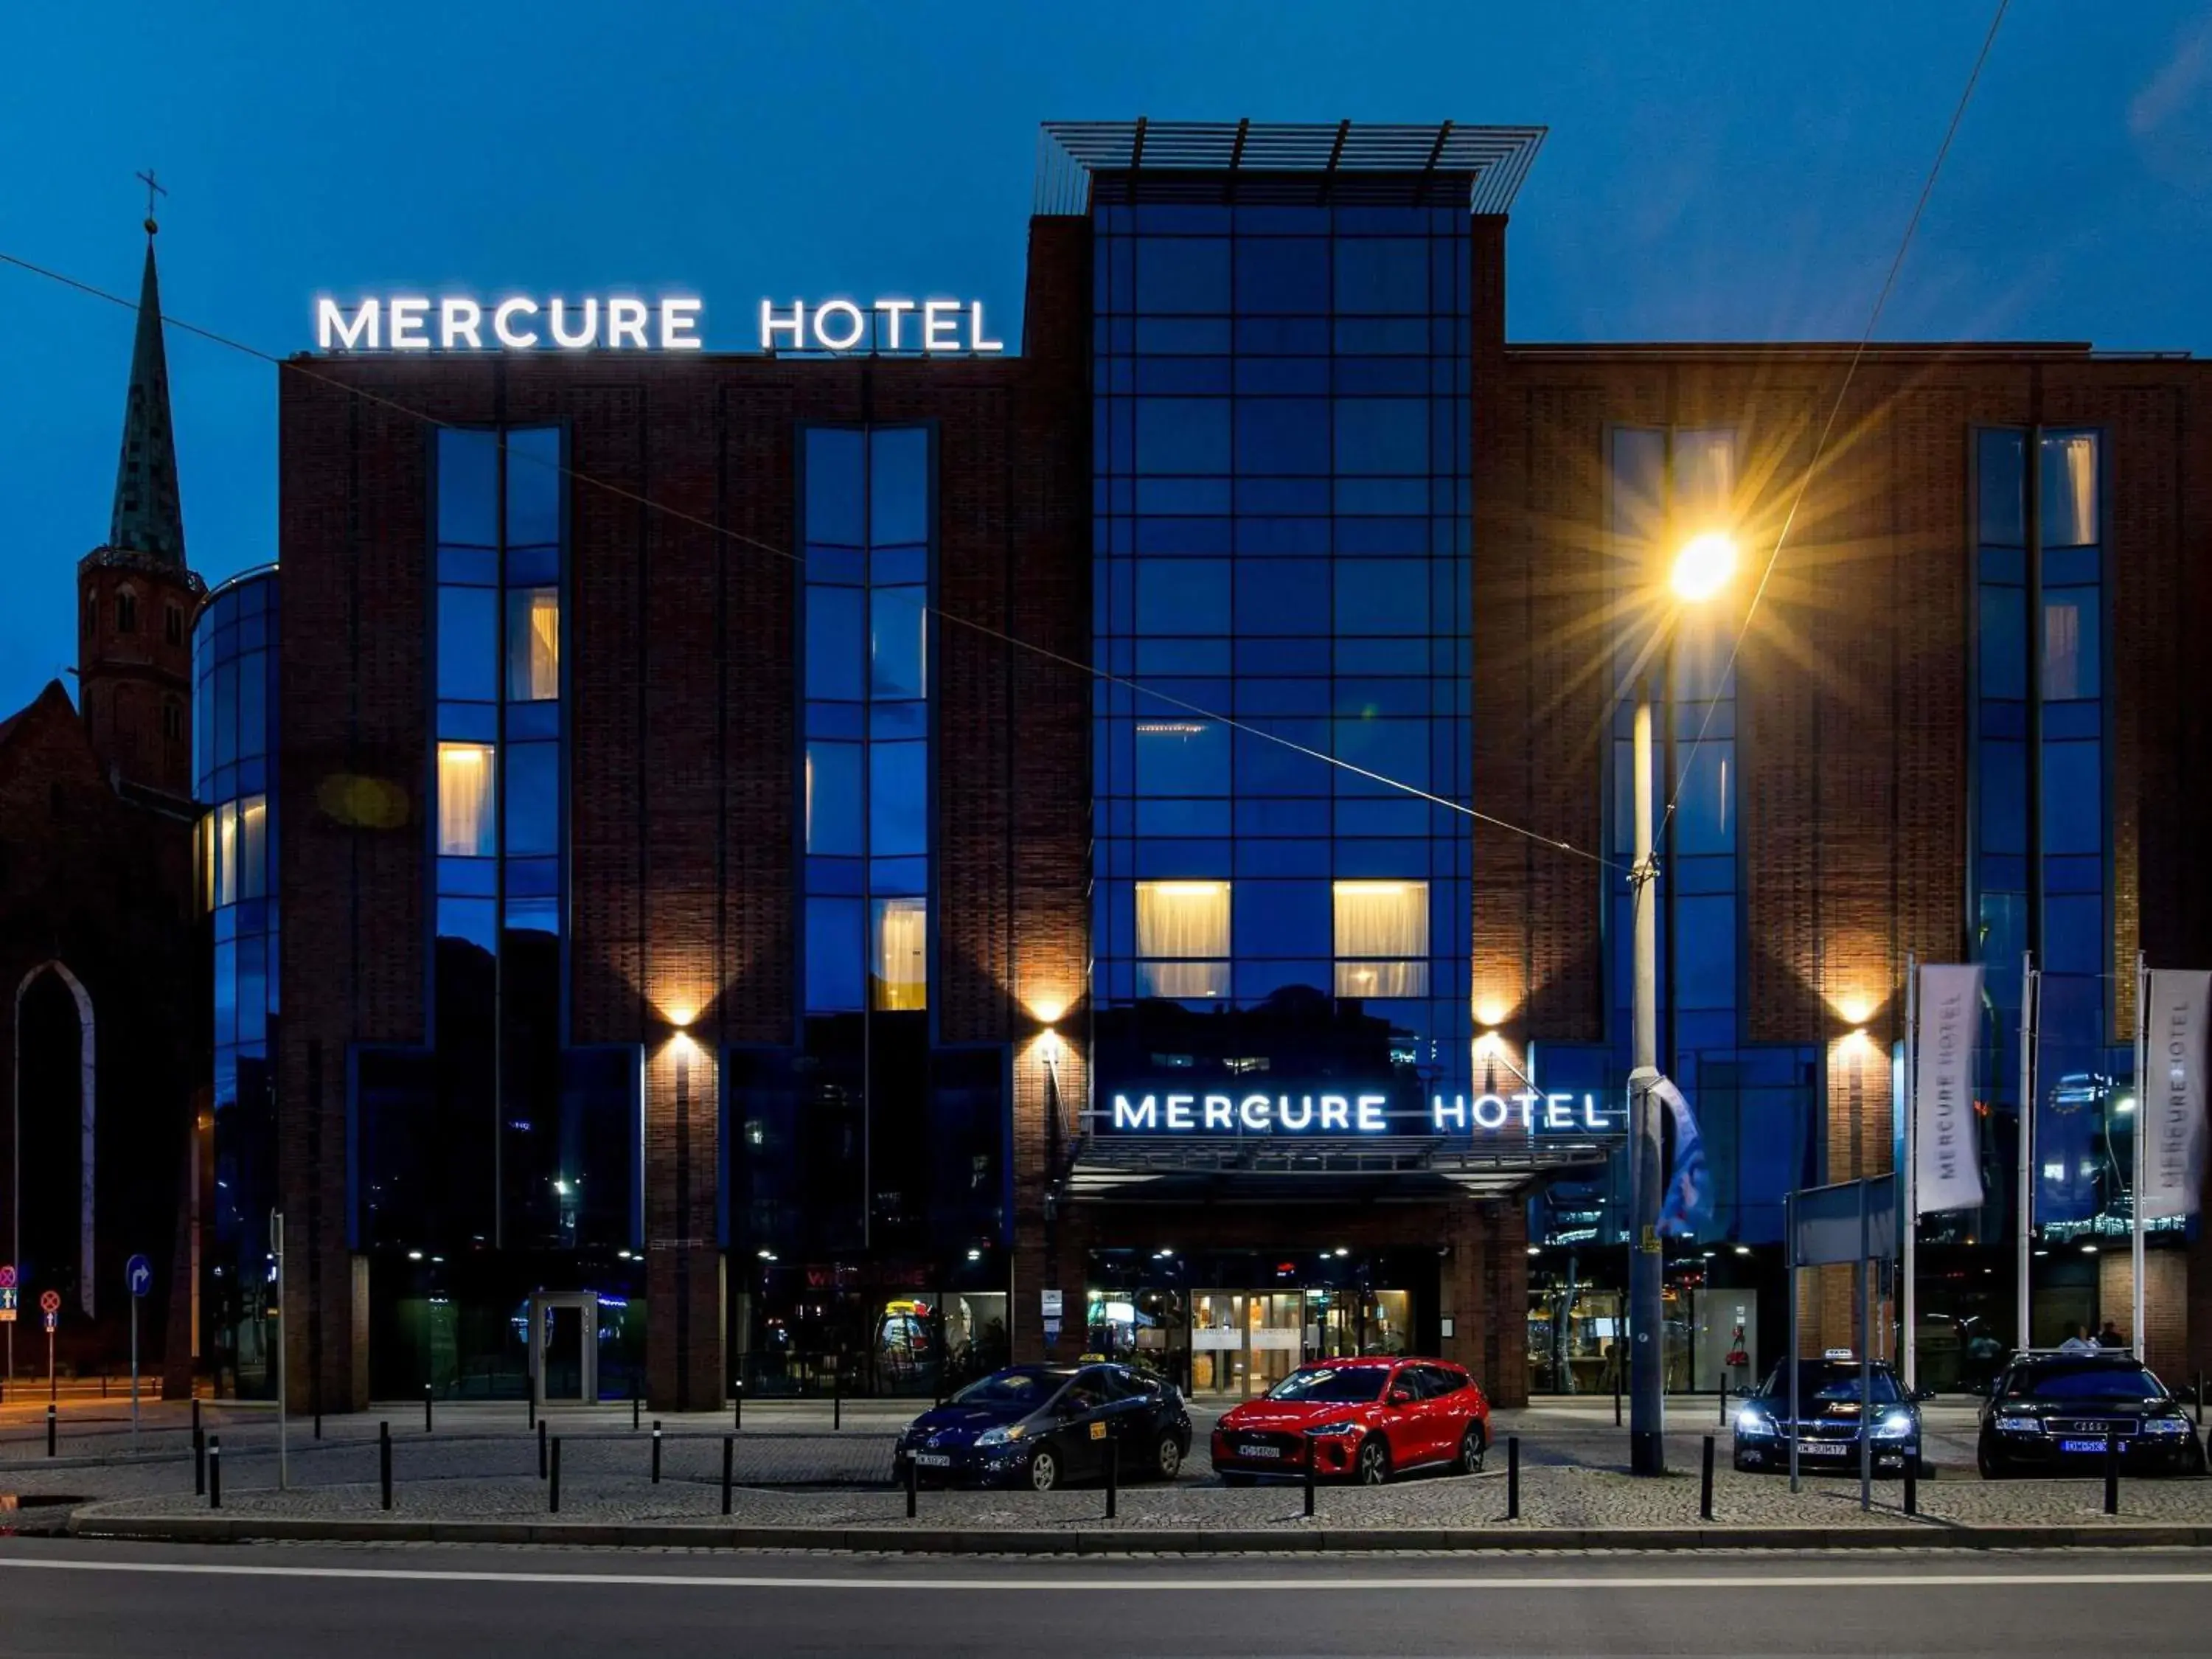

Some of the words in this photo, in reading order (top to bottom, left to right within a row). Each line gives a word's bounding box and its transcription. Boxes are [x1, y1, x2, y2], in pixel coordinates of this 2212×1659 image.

[317, 296, 703, 349] MERCURE
[760, 299, 1004, 350] HOTEL
[1938, 993, 1961, 1066] HOTEL
[1114, 1094, 1387, 1130] MERCURE
[1433, 1093, 1610, 1128] HOTEL
[1936, 1075, 1955, 1180] MERCURE
